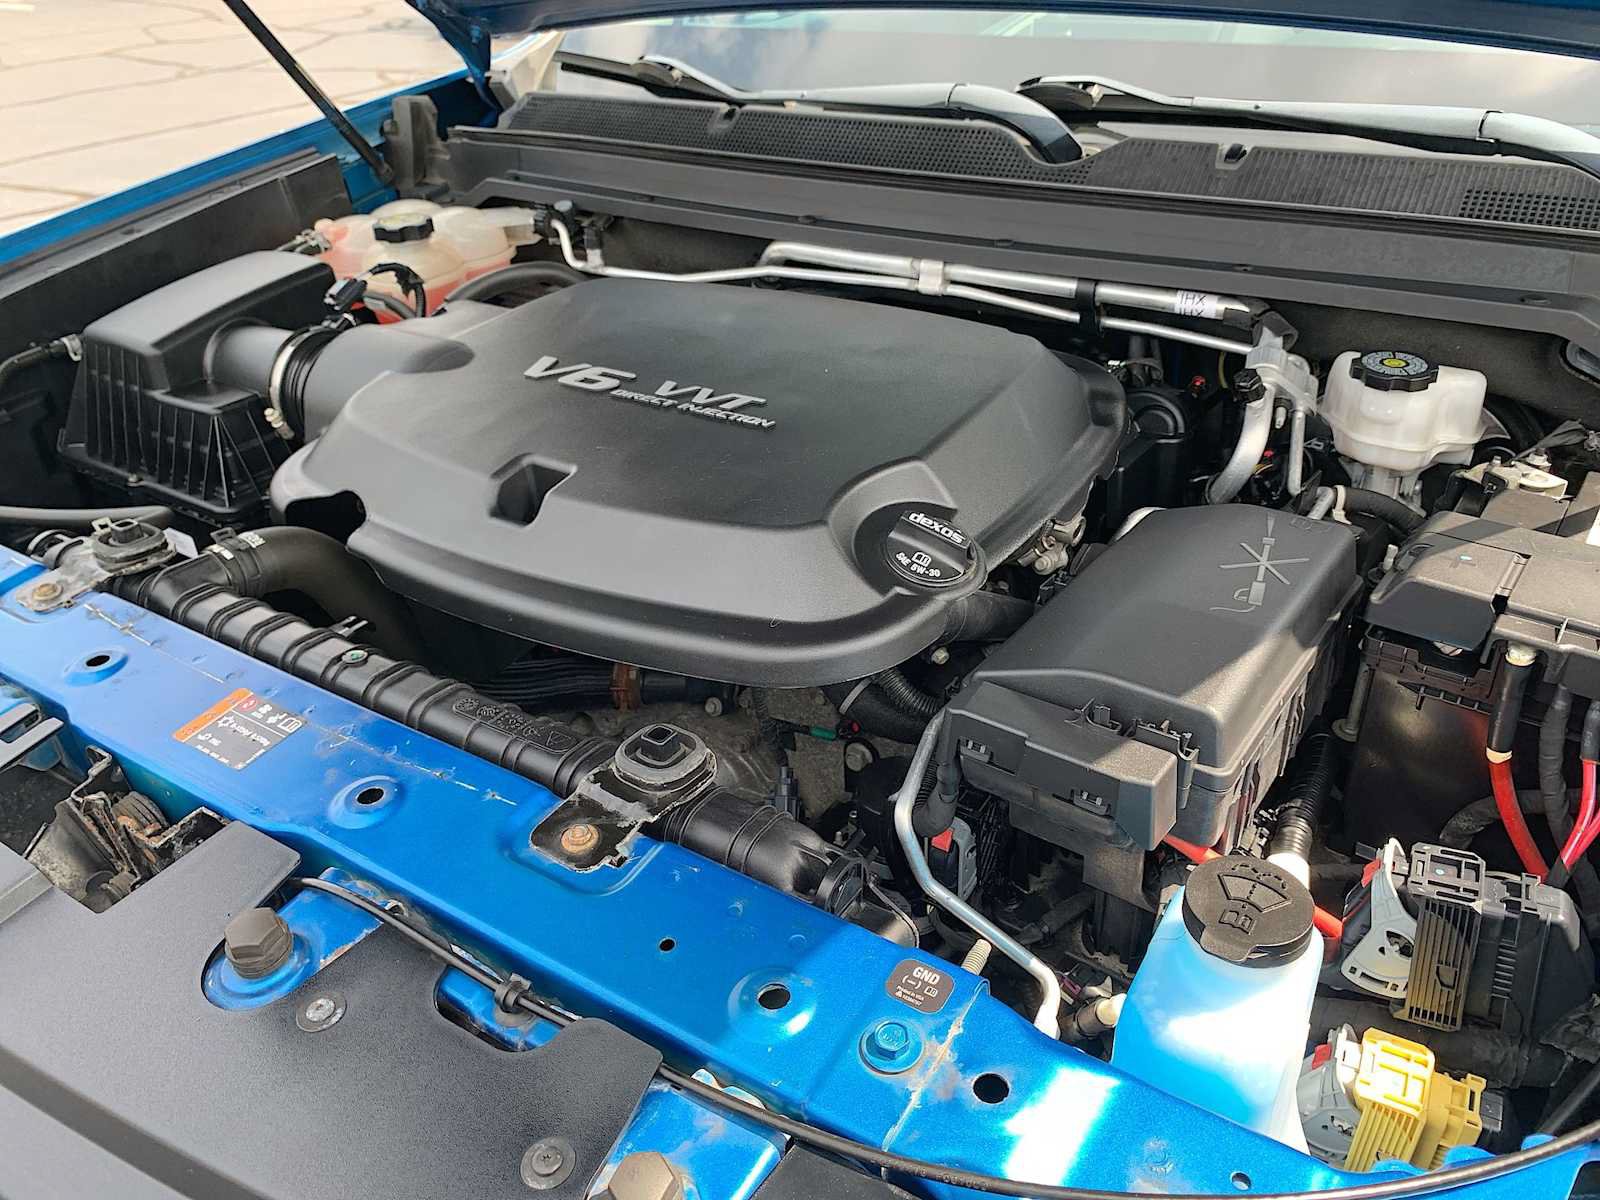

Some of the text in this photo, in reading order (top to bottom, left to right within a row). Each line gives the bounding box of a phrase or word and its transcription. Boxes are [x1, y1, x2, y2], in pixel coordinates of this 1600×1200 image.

[523, 355, 768, 410] V6 VVT
[610, 388, 777, 428] DIRECT INJECTION
[908, 512, 966, 544] dexos
[896, 552, 911, 566] SAE
[912, 966, 940, 985] GND
